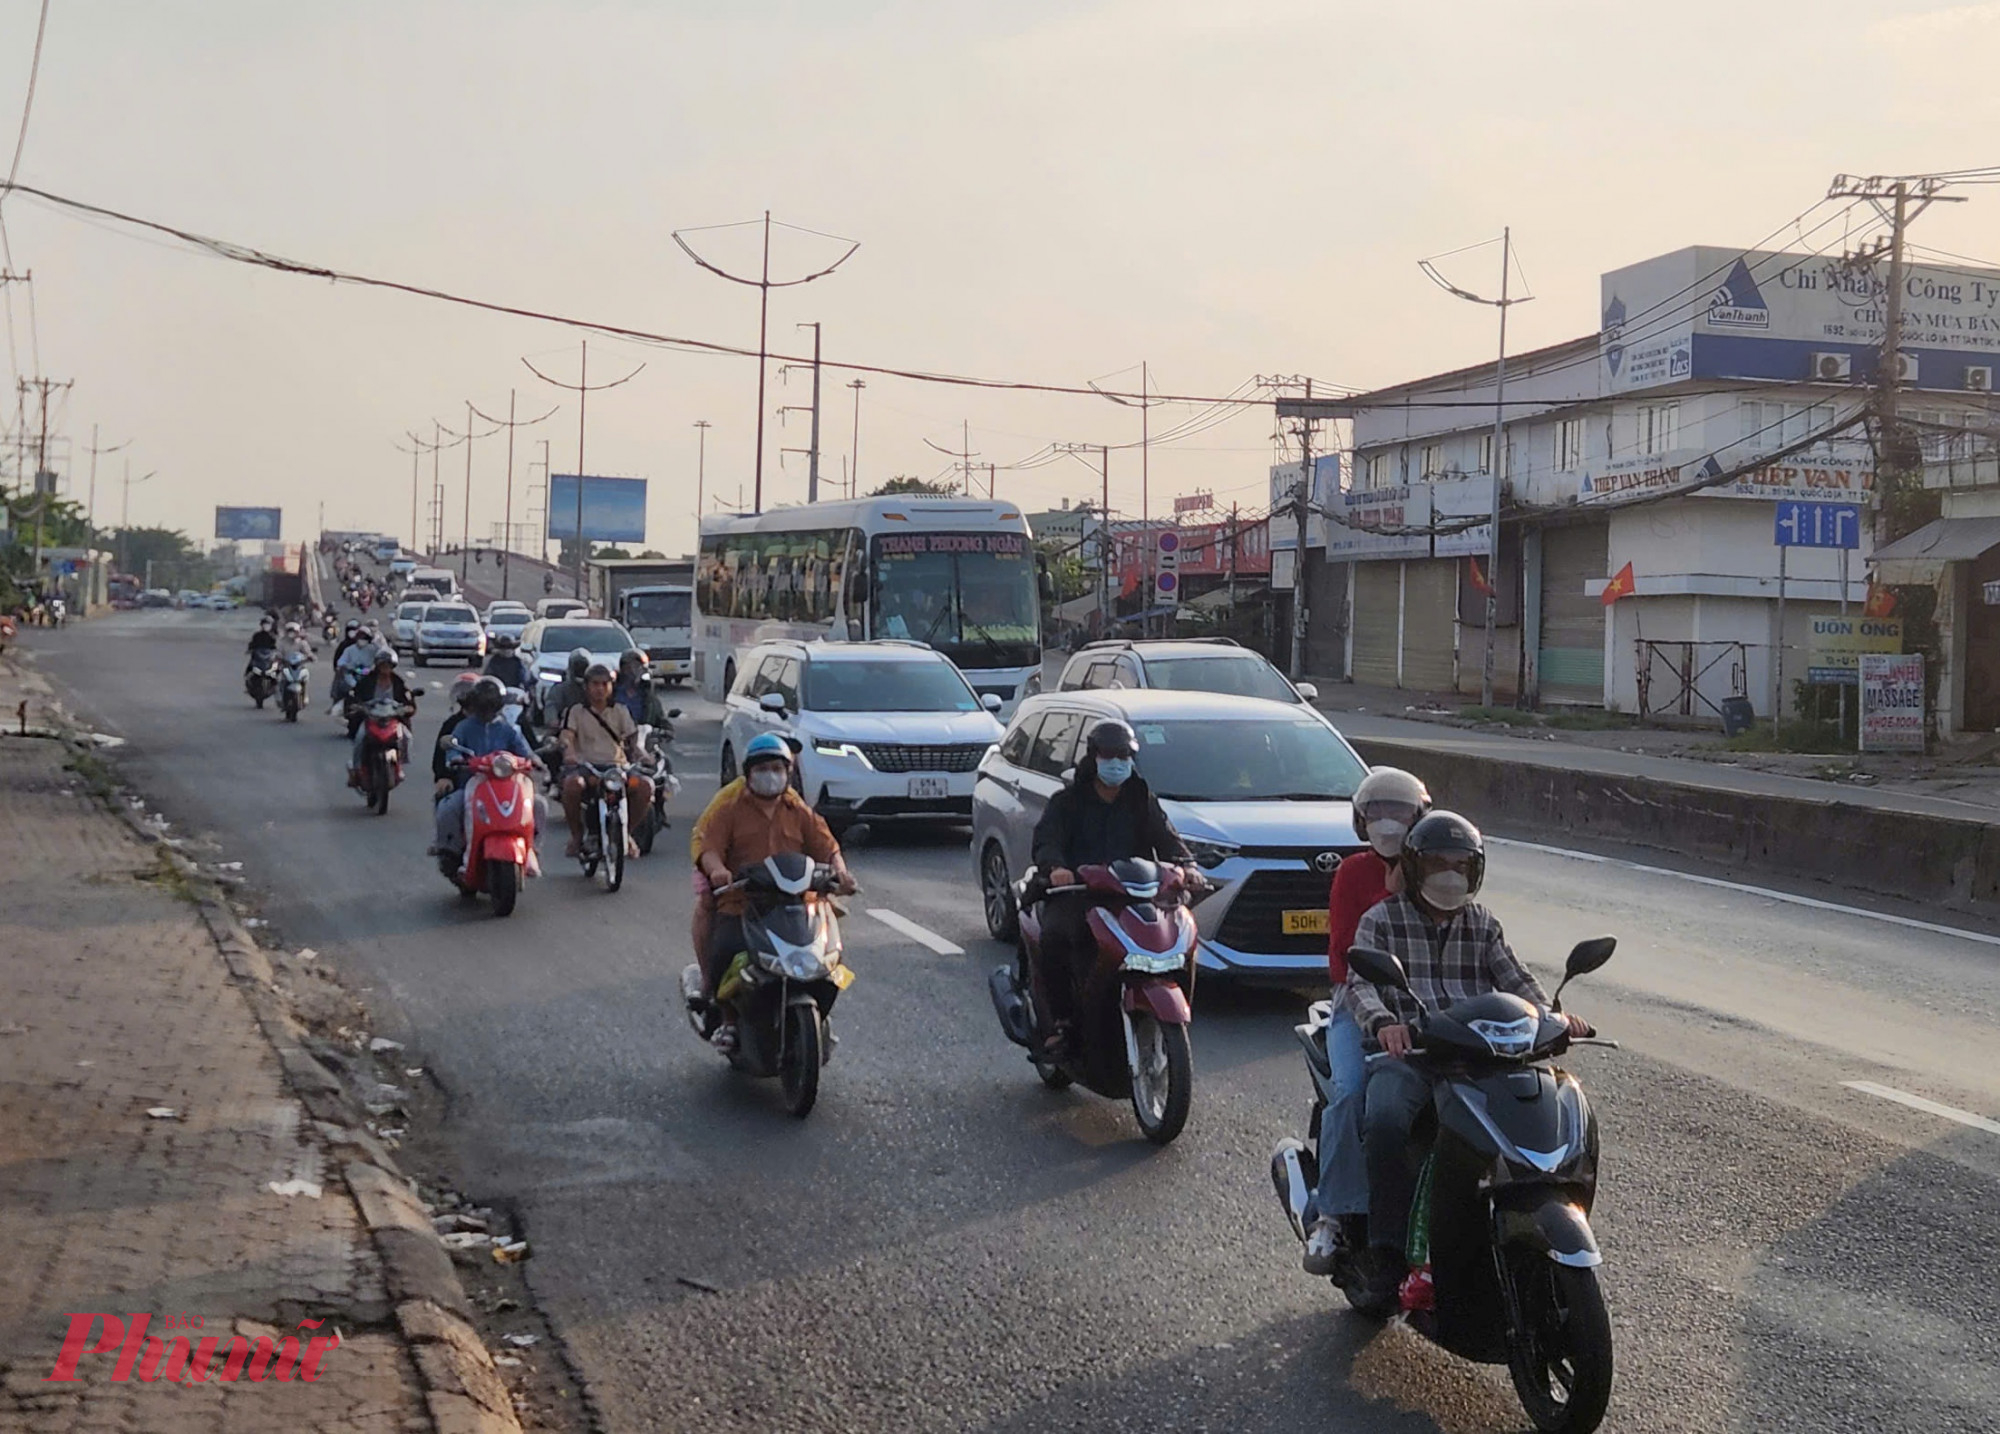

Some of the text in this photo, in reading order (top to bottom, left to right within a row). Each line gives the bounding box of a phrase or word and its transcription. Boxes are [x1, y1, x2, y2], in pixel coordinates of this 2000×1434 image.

[1779, 268, 1817, 290] Chi
[1906, 277, 1962, 305] Công
[1971, 281, 2000, 308] Ty
[1926, 314, 1963, 330] MUA
[1867, 689, 1920, 708] MASSAGE
